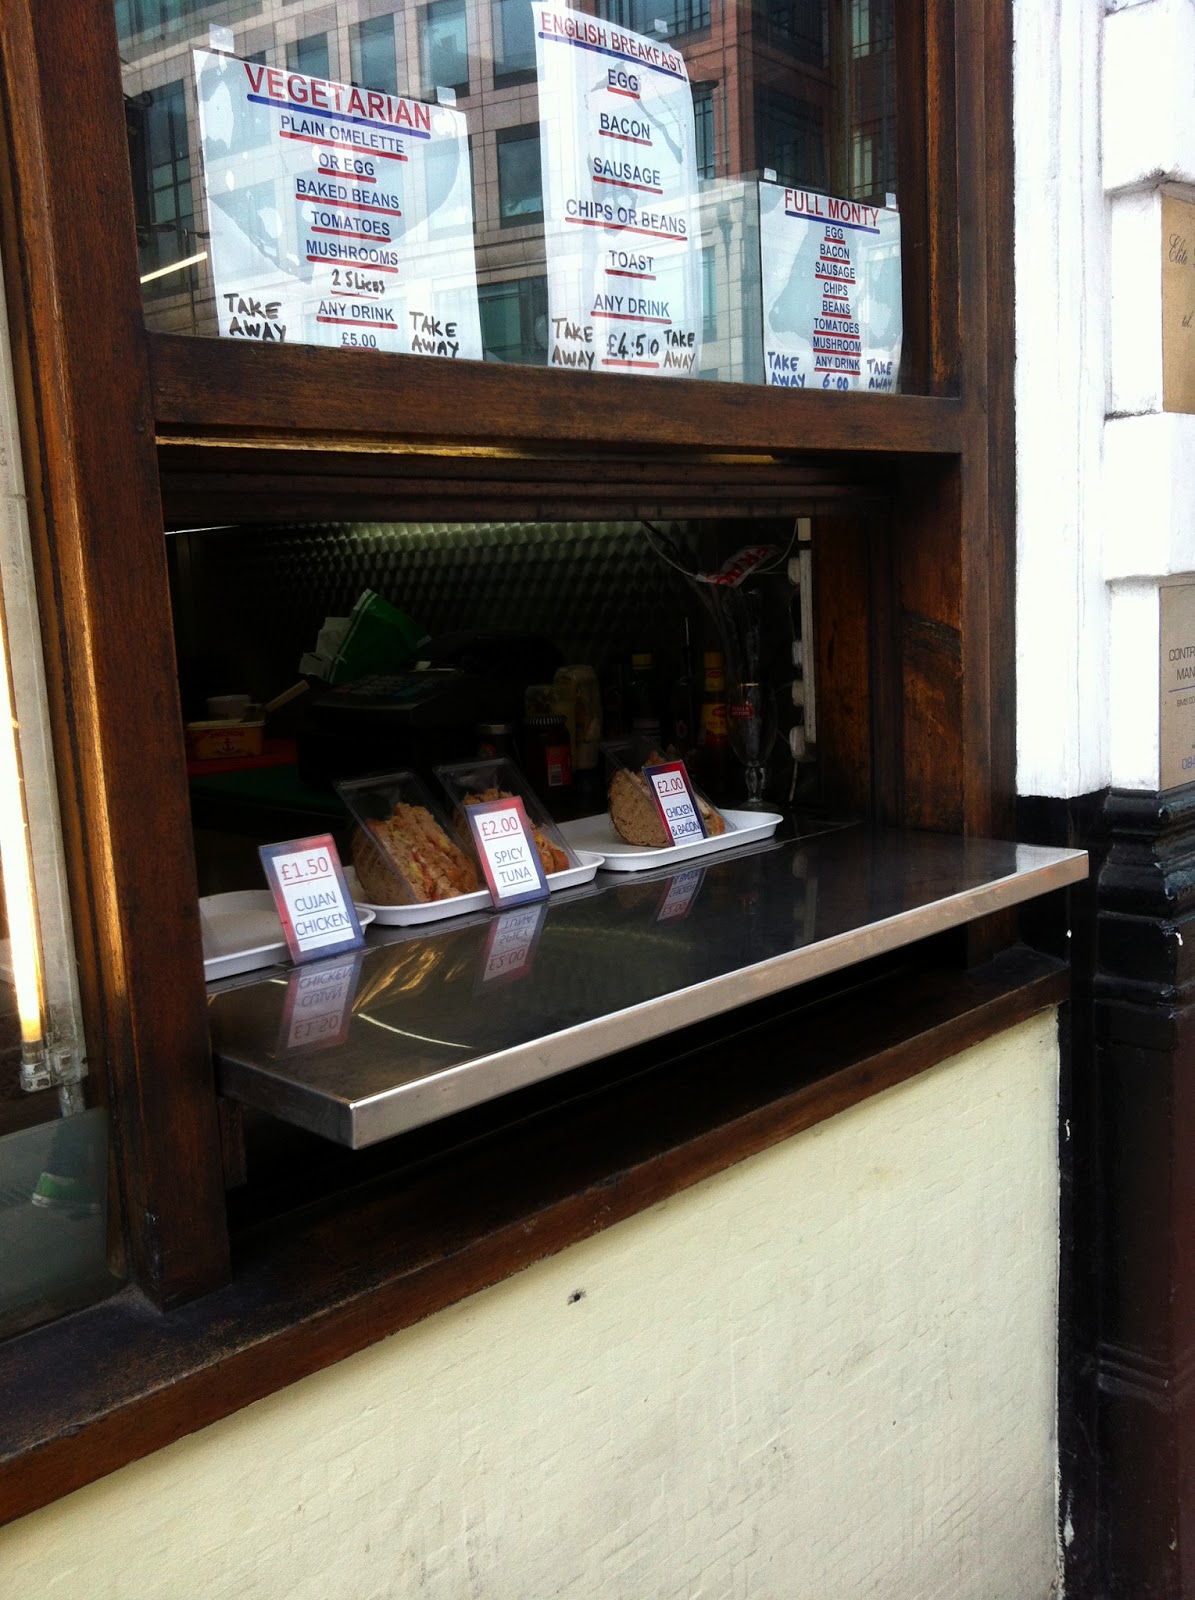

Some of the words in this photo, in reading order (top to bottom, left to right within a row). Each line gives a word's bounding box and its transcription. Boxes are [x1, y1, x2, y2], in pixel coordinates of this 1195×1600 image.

[541, 11, 607, 47] ENGLISH
[611, 31, 682, 74] BREAKFAST
[608, 68, 638, 91] EGG
[244, 63, 431, 131] VEGETARIAN
[281, 115, 325, 138] PLAIN
[329, 126, 404, 153] OMELETTE
[600, 112, 650, 139] BACON
[319, 153, 339, 171] OR
[344, 158, 375, 176] EGG
[593, 157, 661, 186] SAUSAGE
[296, 178, 347, 201] BAKED
[352, 188, 399, 209] BEANS
[566, 199, 613, 221] CHIPS
[617, 207, 637, 225] OR
[641, 211, 686, 234] BEANS
[785, 189, 823, 216] FULL
[828, 199, 879, 227] MONTY
[311, 211, 390, 236] TOMATOES
[825, 226, 844, 239] EGG
[306, 239, 399, 266] MUSHROOMS
[609, 250, 654, 271] TOAST
[820, 244, 850, 259] BACON
[332, 269, 341, 286] 2
[815, 262, 855, 279] SAUSAGE
[823, 281, 848, 296] CHIPS
[224, 293, 282, 319] TAKE
[318, 300, 346, 316] ANY
[351, 305, 394, 321] DRINK
[594, 294, 624, 312] ANY
[628, 298, 670, 317] DRINK
[822, 300, 850, 315] BEANS
[229, 317, 286, 342] AWAY
[409, 311, 457, 338] TAKE
[552, 317, 593, 343] TAKE
[814, 318, 859, 334] TOMATOES
[341, 332, 376, 347] £5.00
[412, 335, 460, 358] AWAY
[664, 329, 695, 347] TAKE
[813, 336, 861, 351] MUSHROOM
[552, 345, 595, 370] AWAY
[663, 350, 695, 374] AWAY
[767, 352, 799, 372] TAKE
[815, 356, 832, 368] ANY
[835, 357, 860, 370] DRINK
[867, 358, 893, 375] TAKE
[771, 372, 805, 388] AWAY
[868, 377, 893, 392] AWAY
[657, 778, 683, 793] £2.00
[666, 804, 693, 818] CHICKEN
[482, 816, 518, 836] £2.00
[671, 826, 678, 836] &
[677, 821, 700, 834] BACON
[494, 847, 523, 864] SPICY
[281, 856, 329, 880] £1.50
[499, 866, 532, 883] TUNA
[294, 891, 337, 912] CUJAN
[295, 911, 350, 936] CHICKEN
